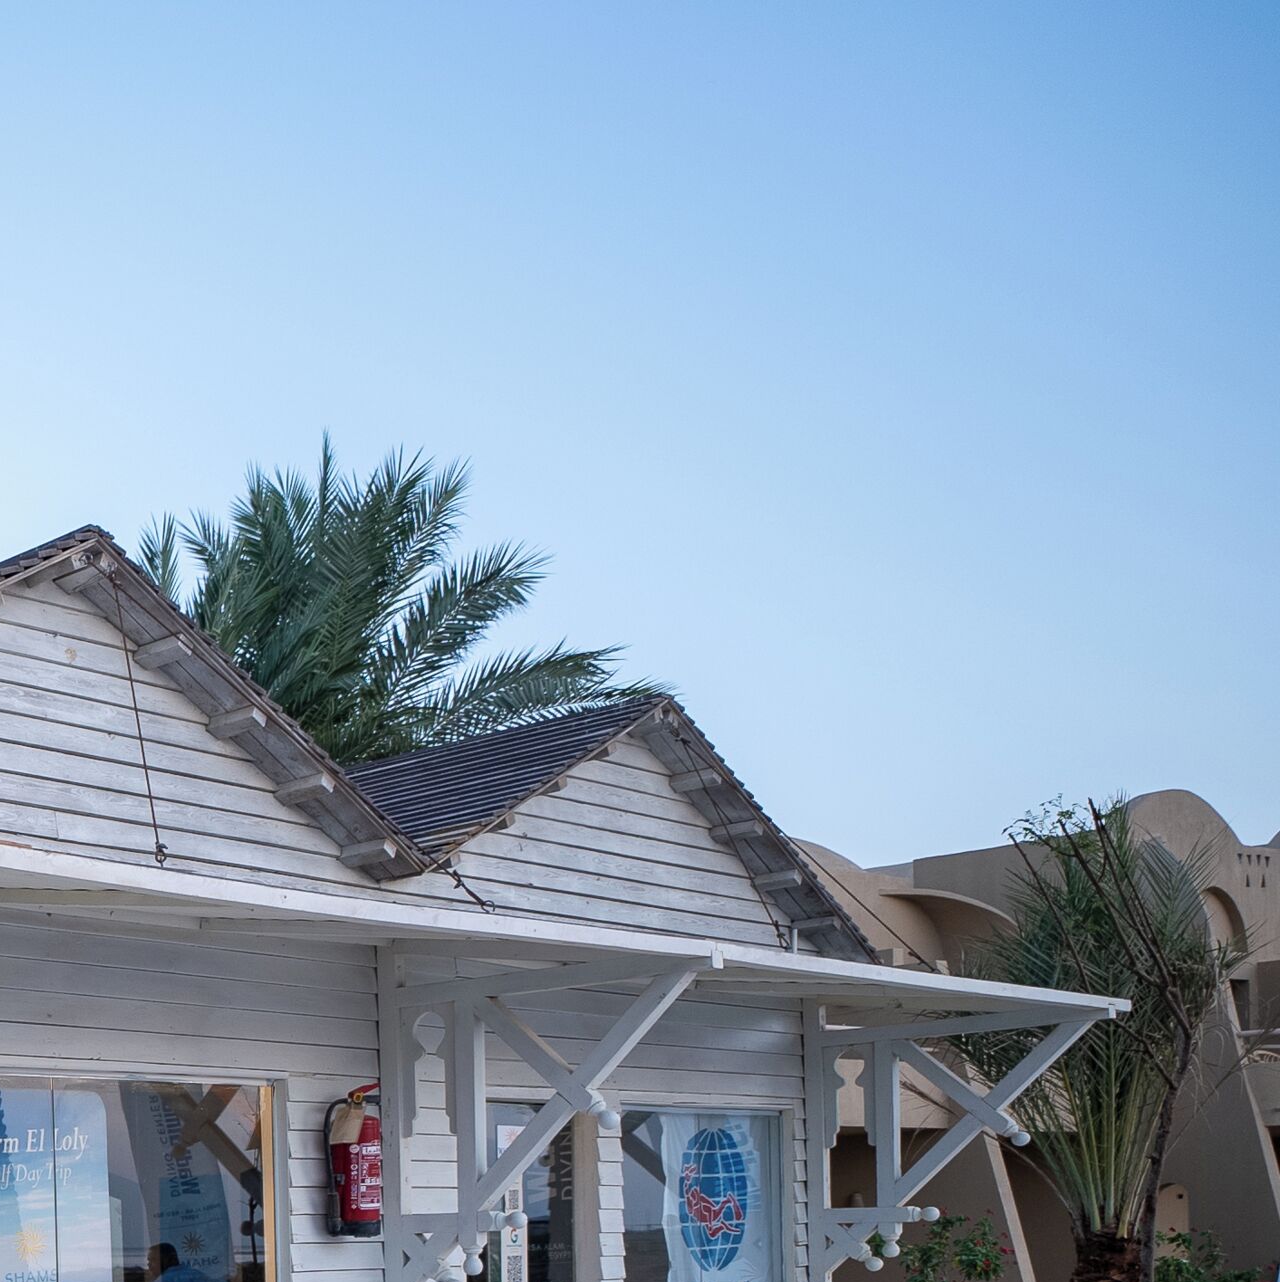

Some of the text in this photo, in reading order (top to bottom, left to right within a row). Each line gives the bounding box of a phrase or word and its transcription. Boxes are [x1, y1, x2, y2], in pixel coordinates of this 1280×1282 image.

[26, 1128, 46, 1153] El
[50, 1126, 89, 1160] Loly
[15, 1163, 44, 1188] Day
[560, 1121, 573, 1201] DIVIN
